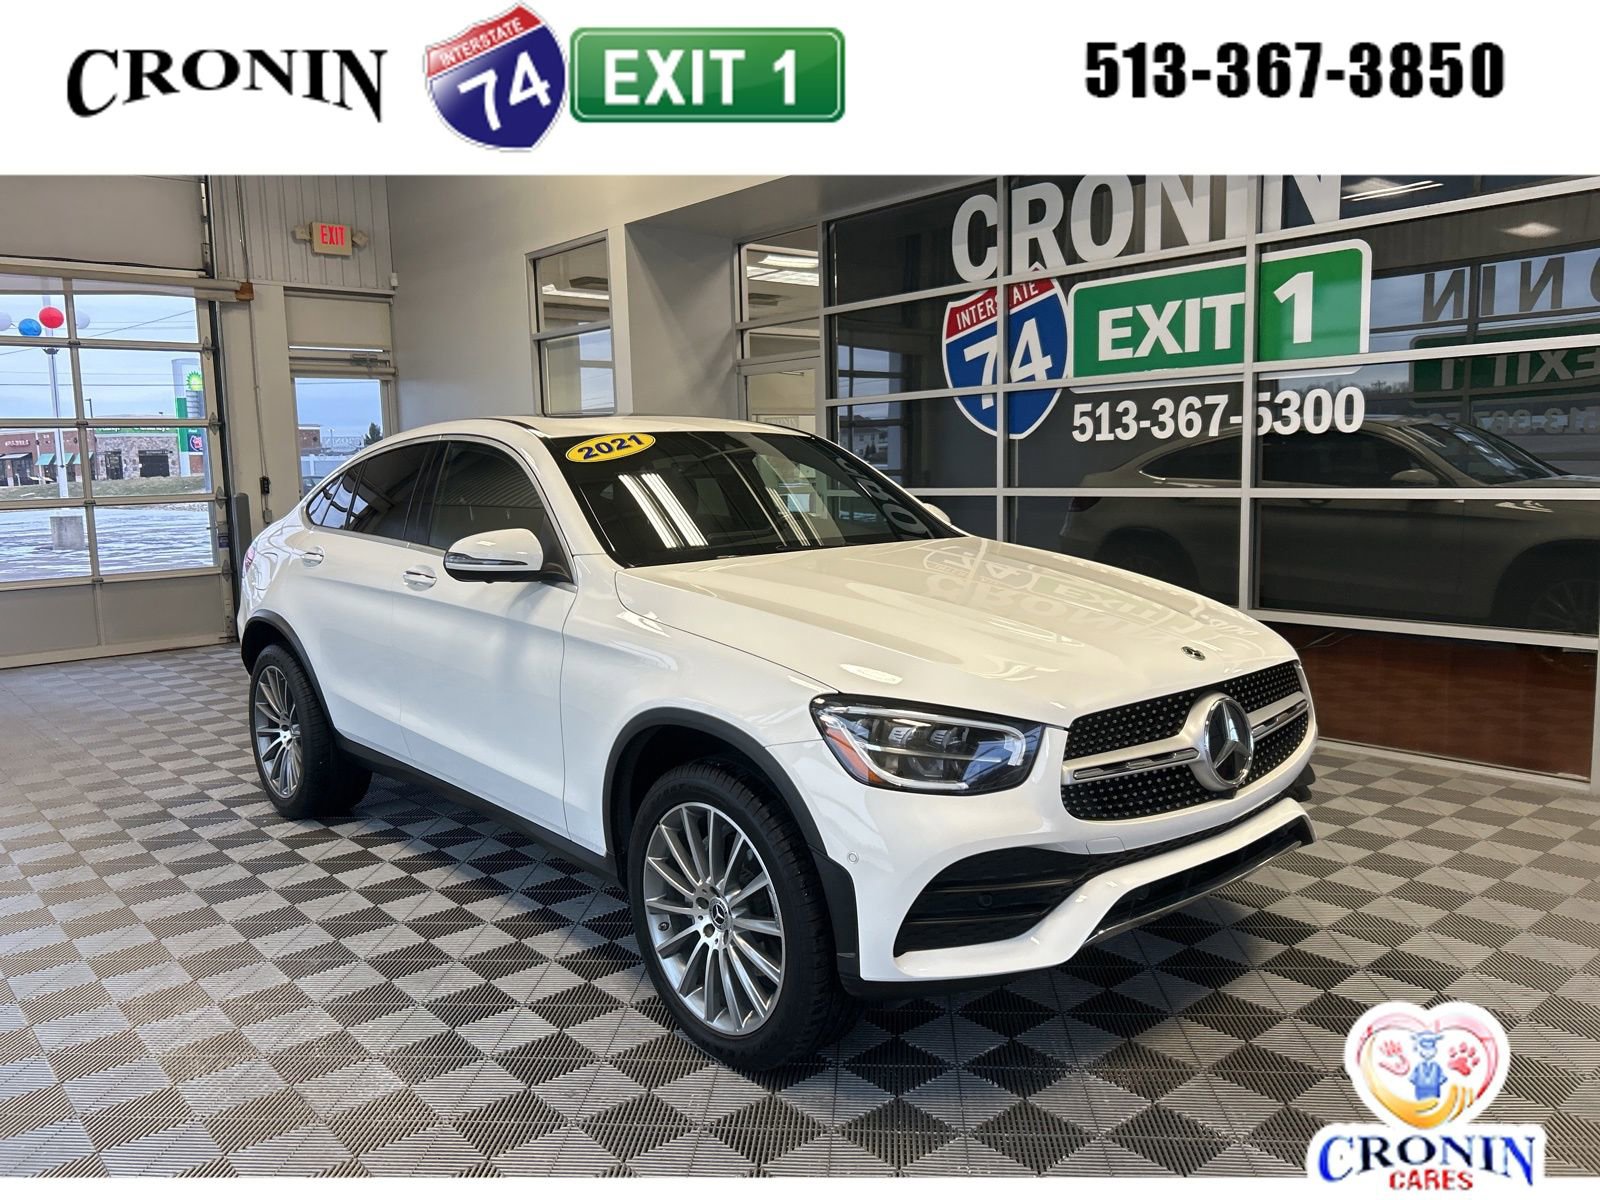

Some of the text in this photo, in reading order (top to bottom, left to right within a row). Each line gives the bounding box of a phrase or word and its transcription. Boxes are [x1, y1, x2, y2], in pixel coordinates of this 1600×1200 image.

[320, 223, 346, 247] EXIT
[951, 174, 1341, 284] CRONIN
[956, 281, 1039, 331] INTERATE
[1098, 271, 1314, 362] EXIT 1
[963, 316, 1053, 411] 74
[1071, 386, 1366, 442] 513-367-5300
[577, 434, 644, 460] 2021
